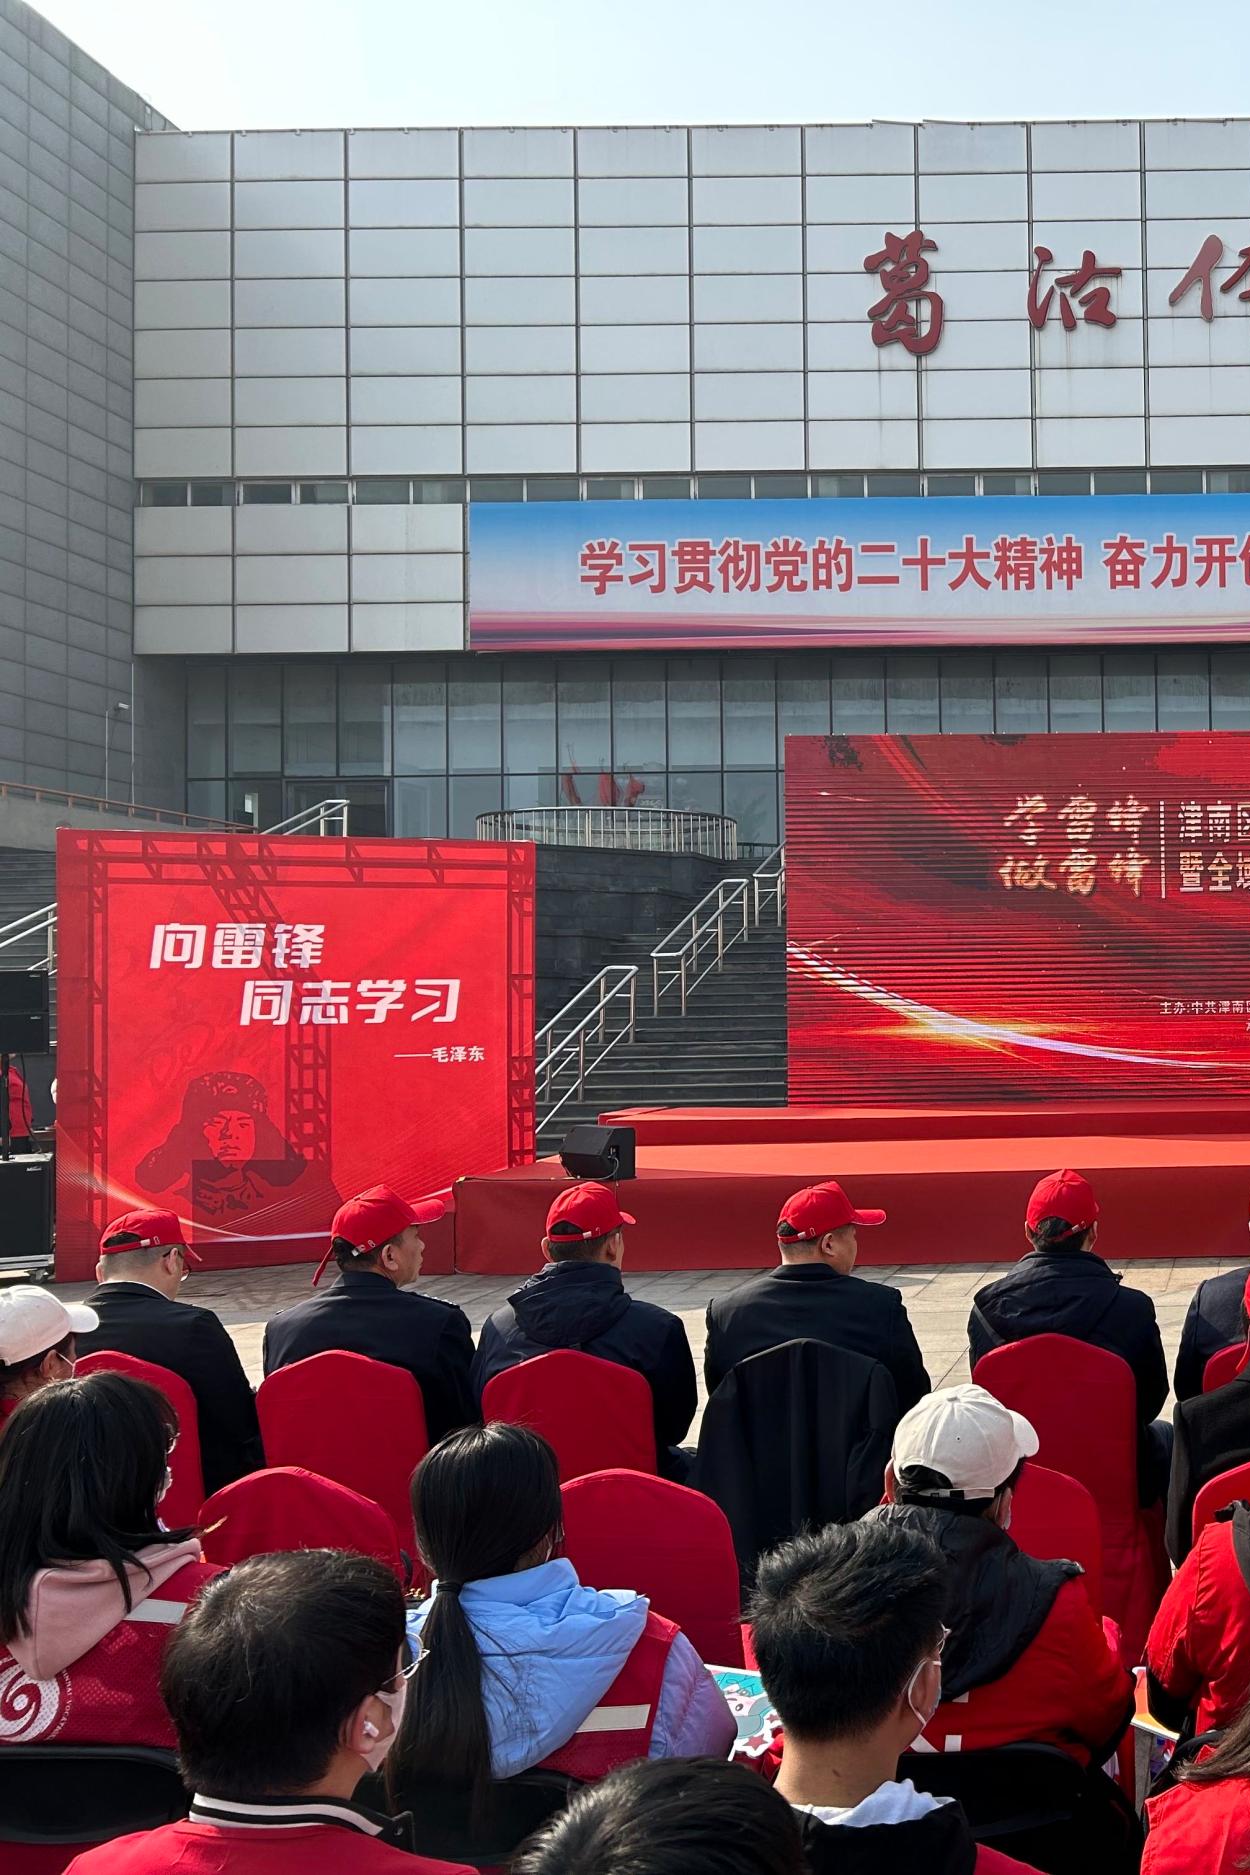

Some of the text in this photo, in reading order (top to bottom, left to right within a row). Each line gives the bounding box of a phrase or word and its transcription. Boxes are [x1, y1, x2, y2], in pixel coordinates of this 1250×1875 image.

[579, 537, 1084, 595] 学习贯彻党的二十大精神
[150, 923, 325, 969] 向雷锋
[239, 978, 461, 1026] 同志学习
